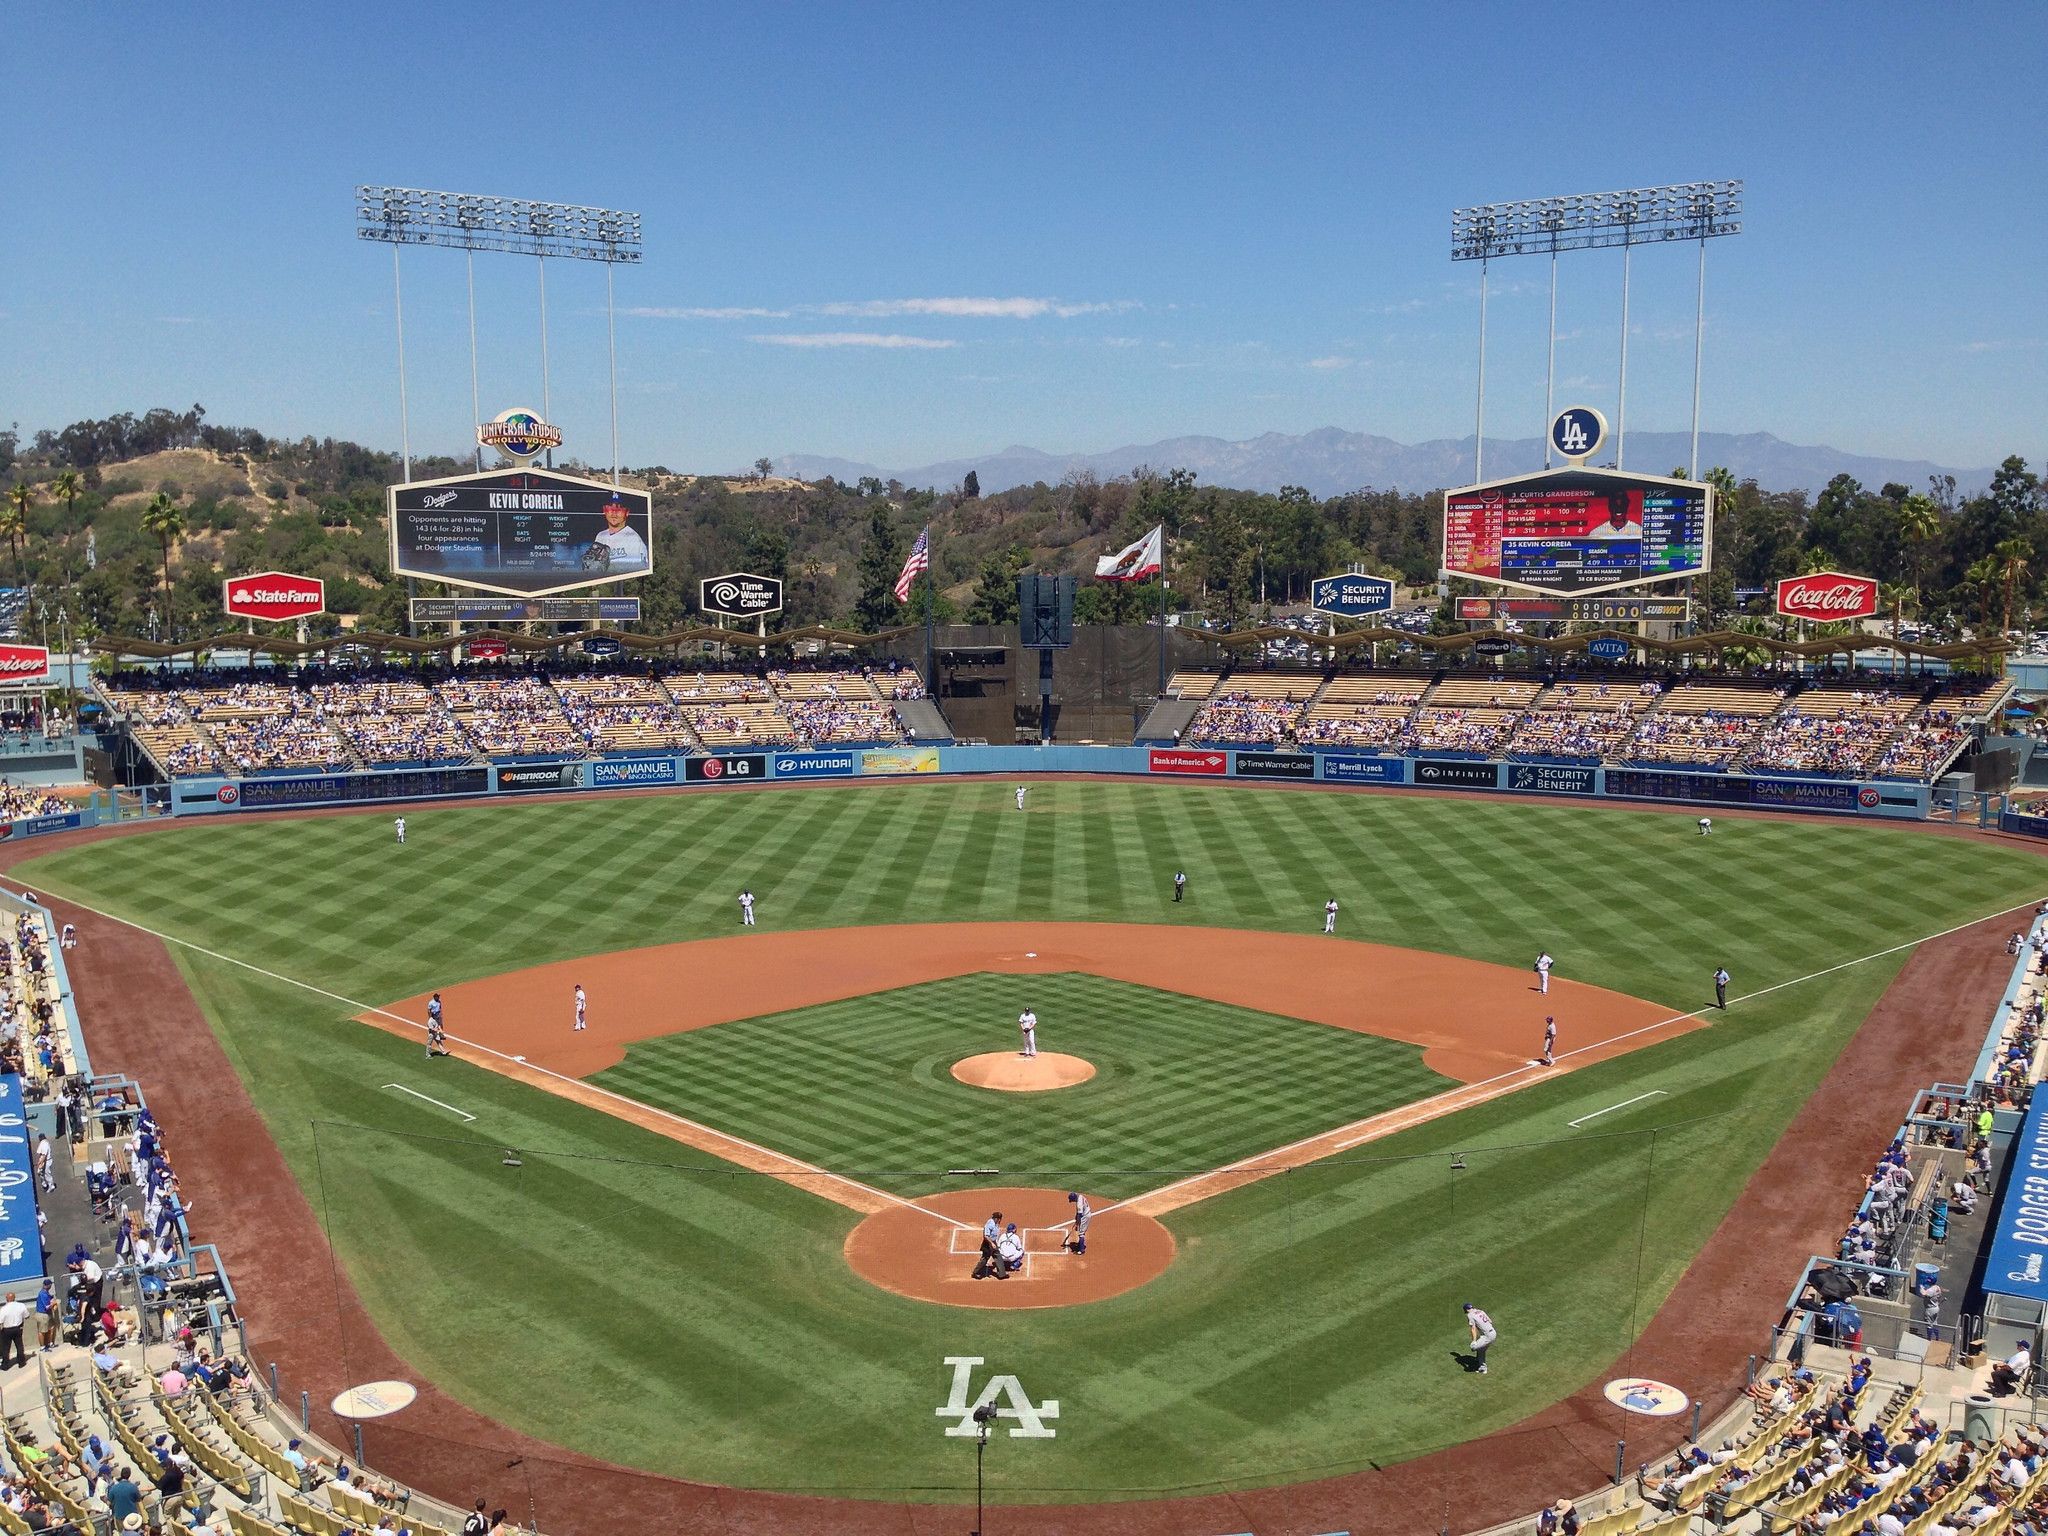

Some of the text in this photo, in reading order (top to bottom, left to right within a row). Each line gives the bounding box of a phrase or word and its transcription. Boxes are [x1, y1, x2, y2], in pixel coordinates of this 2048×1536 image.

[482, 421, 562, 440] UNIVERSAL STUDIOS
[1562, 415, 1587, 450] LA
[494, 437, 553, 446] HOLLYWOOD
[423, 490, 458, 508] Dodgers
[489, 493, 564, 510] KEVIN CORREIA
[409, 515, 449, 523] Opponents
[464, 516, 487, 525] hitting
[435, 535, 479, 543] appearances
[425, 544, 450, 553] Dodger
[740, 582, 763, 590] Time
[1342, 585, 1386, 594] SECURITY
[740, 591, 774, 599] Warner
[740, 599, 767, 607] Cable
[1342, 596, 1381, 604] BENEFIT
[1573, 603, 1599, 611] 0 0 0
[1644, 606, 1685, 614] SUBWAY
[1605, 607, 1639, 617] 0 0 0
[1593, 643, 1624, 652] AVITA
[595, 762, 674, 775] SAN MANUEL
[727, 761, 749, 774] LG
[800, 759, 851, 769] HYUNDAI
[1265, 761, 1290, 769] Warner
[1339, 763, 1382, 772] Merrill Lynch
[1442, 770, 1491, 779] INFINITI
[1538, 768, 1589, 780] SECURITY
[246, 784, 272, 795] SAN
[285, 781, 340, 793] MANUEL
[1538, 779, 1582, 790] BENEFIT
[221, 788, 236, 799] 76
[1756, 783, 1852, 798] SAN MANUEL
[1862, 793, 1876, 801] 76
[935, 1357, 1059, 1437] LA
